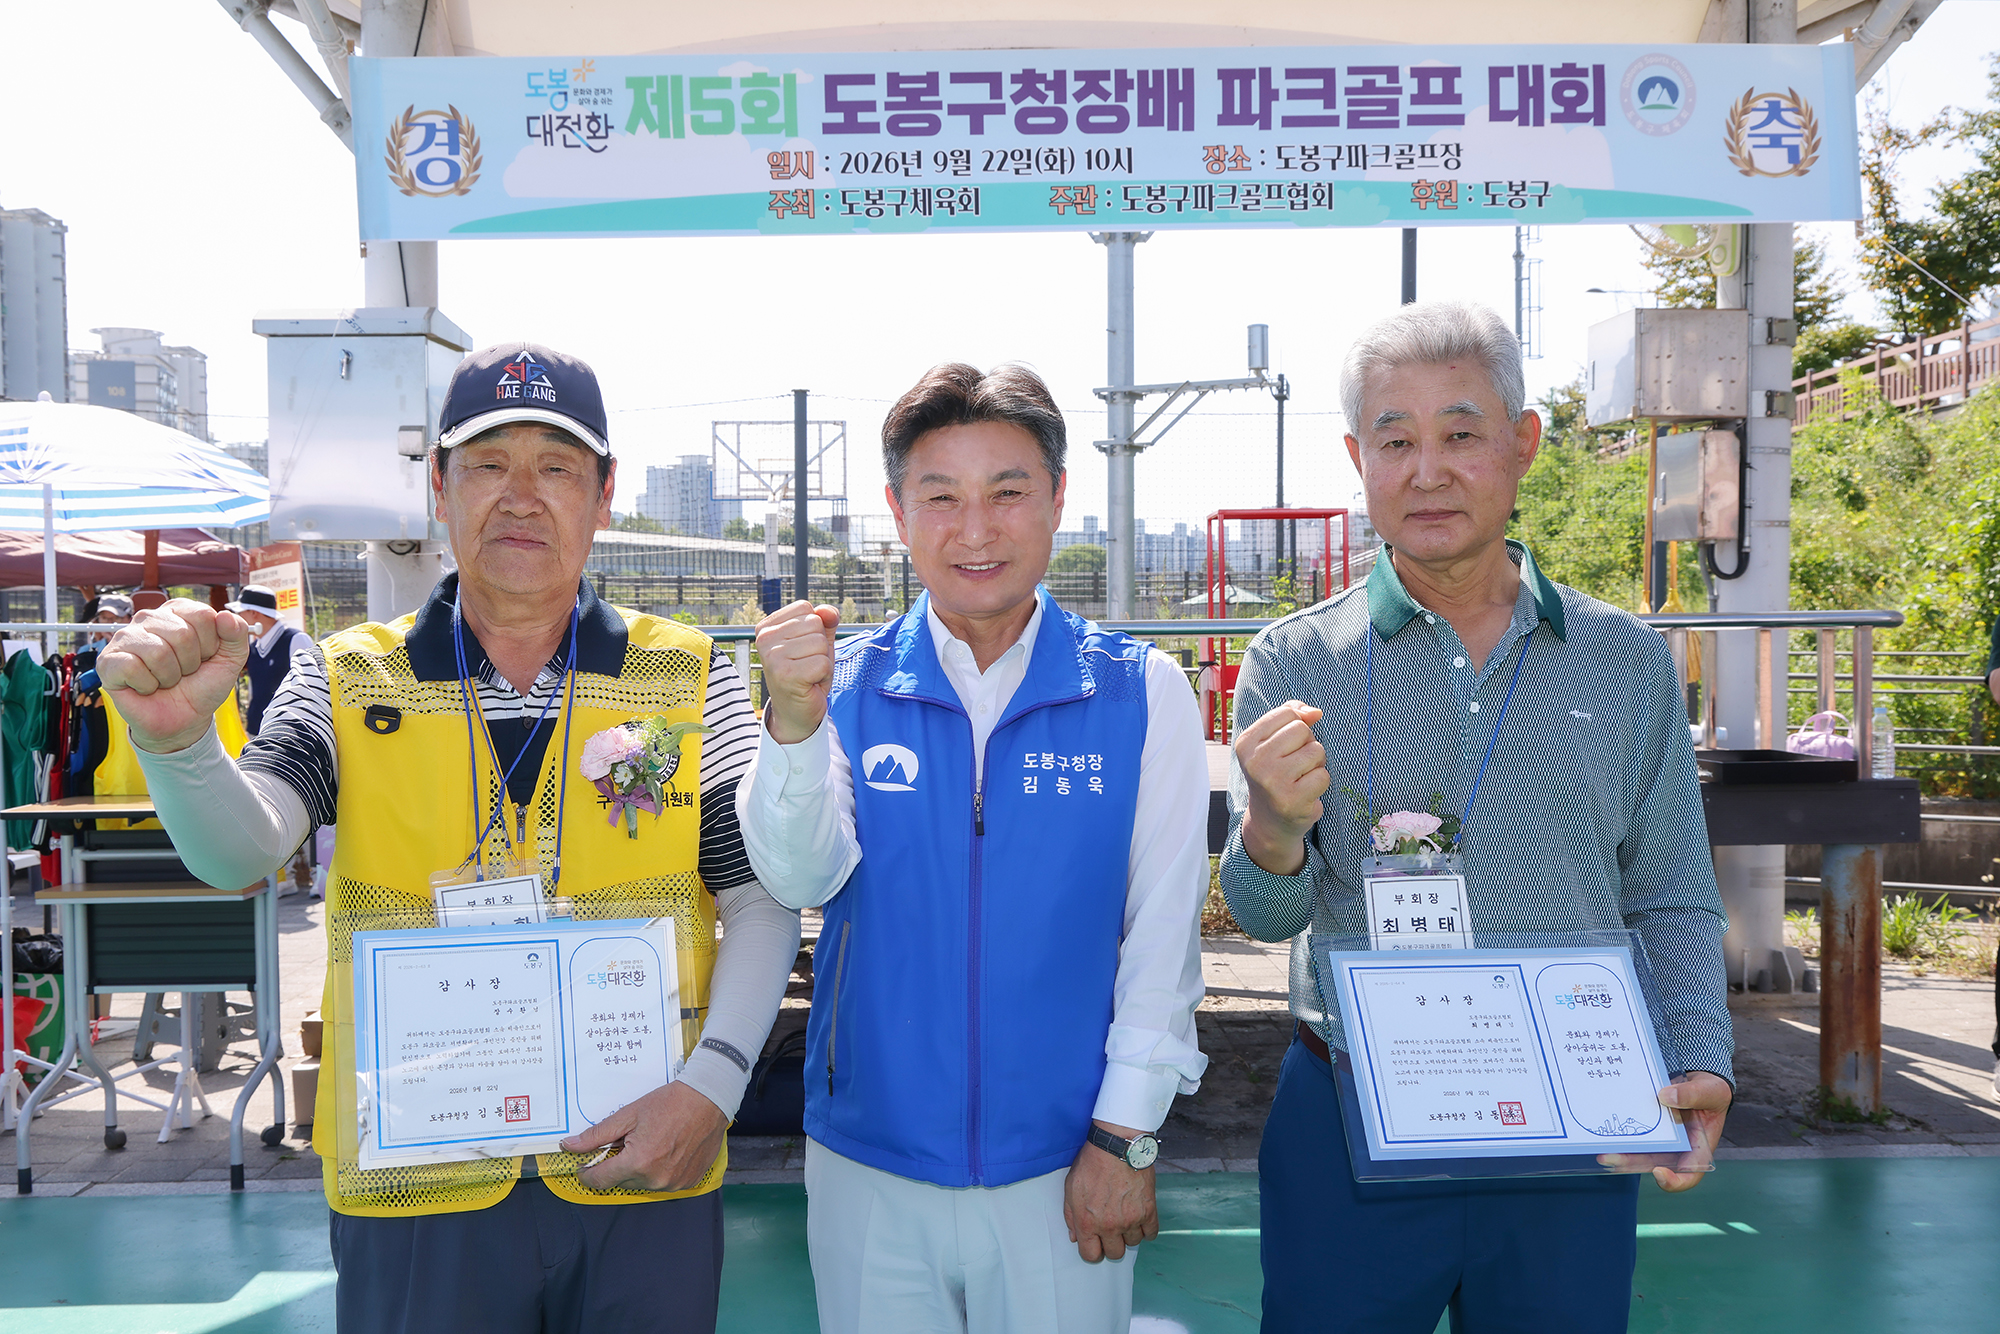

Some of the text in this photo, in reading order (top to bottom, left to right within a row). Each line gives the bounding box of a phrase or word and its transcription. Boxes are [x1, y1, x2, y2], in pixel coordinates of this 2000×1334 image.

[525, 68, 570, 112] 도봉
[625, 63, 1606, 139] 제5회 도봉구청장배 파크골프 대회
[526, 111, 614, 153] 대전환
[1748, 100, 1803, 165] 축
[404, 118, 461, 187] 경
[767, 150, 815, 180] 일시
[839, 149, 923, 178] 2026년
[933, 148, 972, 175] 9월
[981, 146, 1075, 176] 22일(화)
[1085, 146, 1134, 174] 10시
[1202, 144, 1252, 174] 장소
[1275, 142, 1464, 172] 도봉구파크골프장
[768, 188, 816, 219] 주최
[839, 186, 981, 218] 도봉구체육회
[1048, 184, 1098, 215] 주관
[1120, 181, 1334, 213] 도봉구파크골프협회
[1411, 178, 1458, 210] 후원
[1482, 179, 1552, 209] 도봉구
[496, 385, 556, 402] HAE GANG
[1023, 752, 1103, 772] 도봉구청장
[596, 1040, 622, 1051] 당신과
[706, 1040, 725, 1050] TOP
[429, 1111, 469, 1122] 도봉구청장
